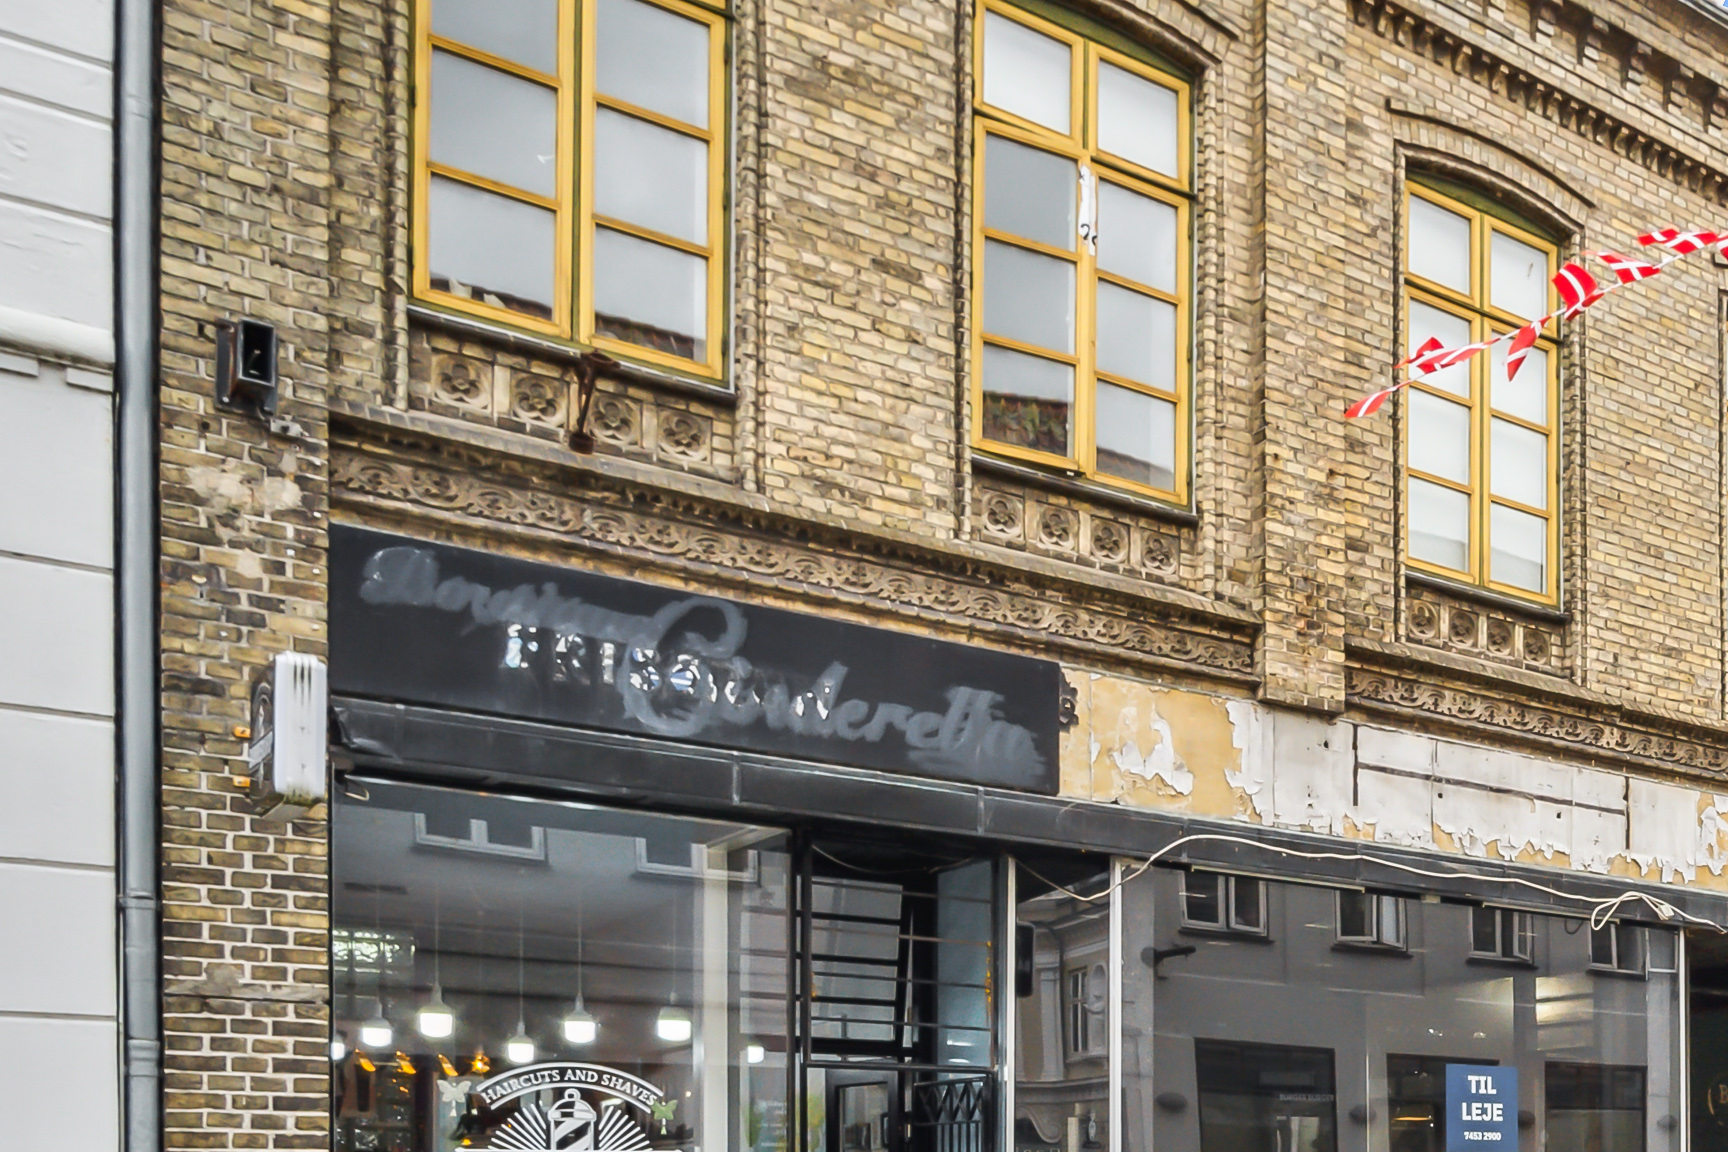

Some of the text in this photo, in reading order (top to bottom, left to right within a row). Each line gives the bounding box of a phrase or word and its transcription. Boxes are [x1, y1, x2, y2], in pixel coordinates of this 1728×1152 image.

[481, 1069, 658, 1106] HAIRCUTS AND SHAVES
[1467, 1074, 1497, 1095] TIL
[1461, 1102, 1504, 1121] LEJE
[1464, 1131, 1502, 1141] 7453 2900
